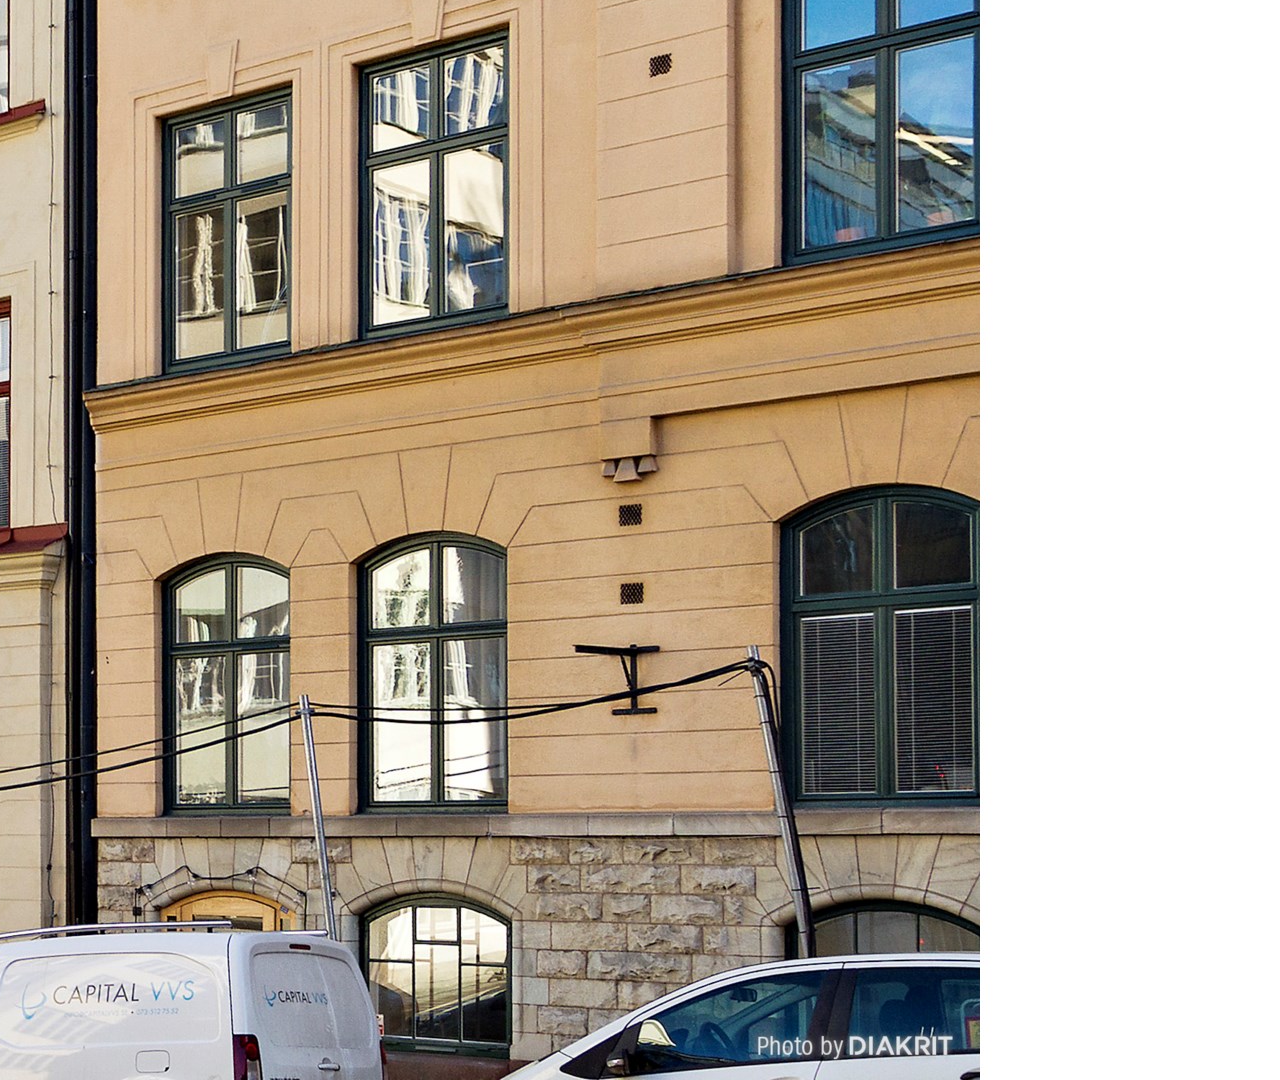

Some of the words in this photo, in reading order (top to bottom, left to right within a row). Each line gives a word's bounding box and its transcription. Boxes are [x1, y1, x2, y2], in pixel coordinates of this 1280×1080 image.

[52, 983, 139, 1005] CAPITAL
[150, 980, 196, 1002] VVS
[278, 991, 312, 1004] CAPITAL
[312, 992, 328, 1005] VVS
